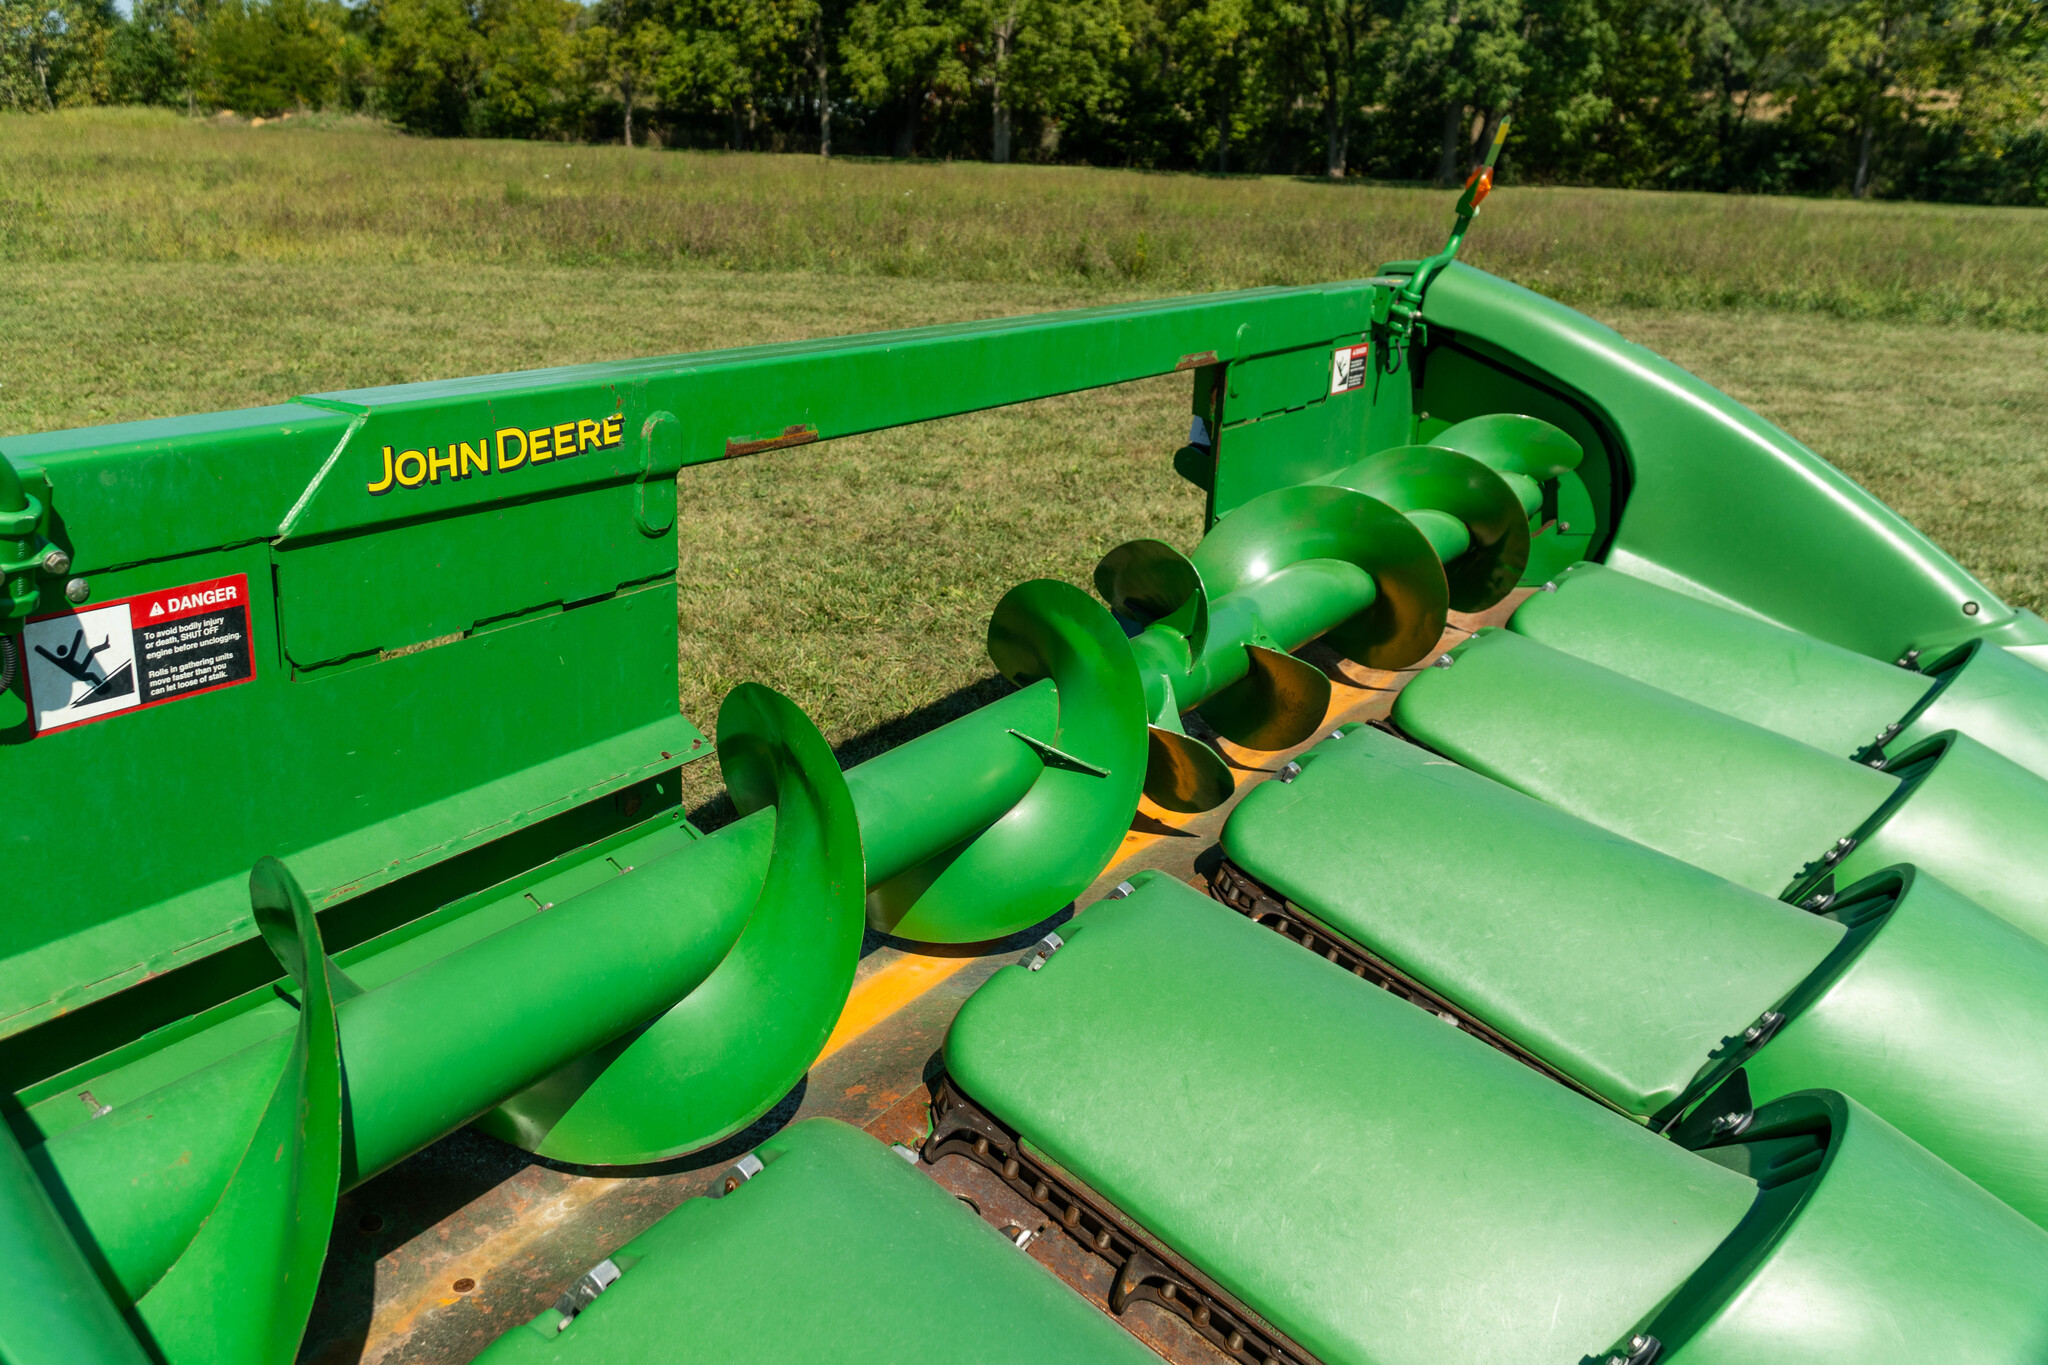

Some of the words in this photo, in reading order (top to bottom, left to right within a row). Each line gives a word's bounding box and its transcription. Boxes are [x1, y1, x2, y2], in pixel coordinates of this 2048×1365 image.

[368, 439, 491, 496] JOHN
[495, 413, 625, 473] DEERE
[168, 586, 237, 613] DANGER
[143, 632, 155, 640] To
[156, 626, 178, 637] avoid
[179, 621, 202, 633] bodily
[204, 616, 225, 627] injury
[145, 642, 155, 650] or
[156, 636, 180, 647] death,
[181, 630, 202, 641] SHUT
[203, 626, 219, 636] OFF
[146, 649, 173, 660] engine
[174, 641, 198, 653] before
[200, 632, 242, 647] unclogging.
[148, 667, 169, 678] Rolls
[170, 665, 178, 673] in
[179, 656, 215, 672] gathering
[215, 652, 234, 662] units
[149, 677, 171, 687] move
[172, 671, 194, 682] faster
[195, 666, 212, 676] than
[213, 663, 227, 673] you
[150, 687, 165, 696] can
[166, 682, 177, 692] let
[178, 678, 199, 689] loose
[199, 674, 208, 684] of
[208, 671, 229, 682] stalk.
[1120, 1214, 1136, 1230] USA
